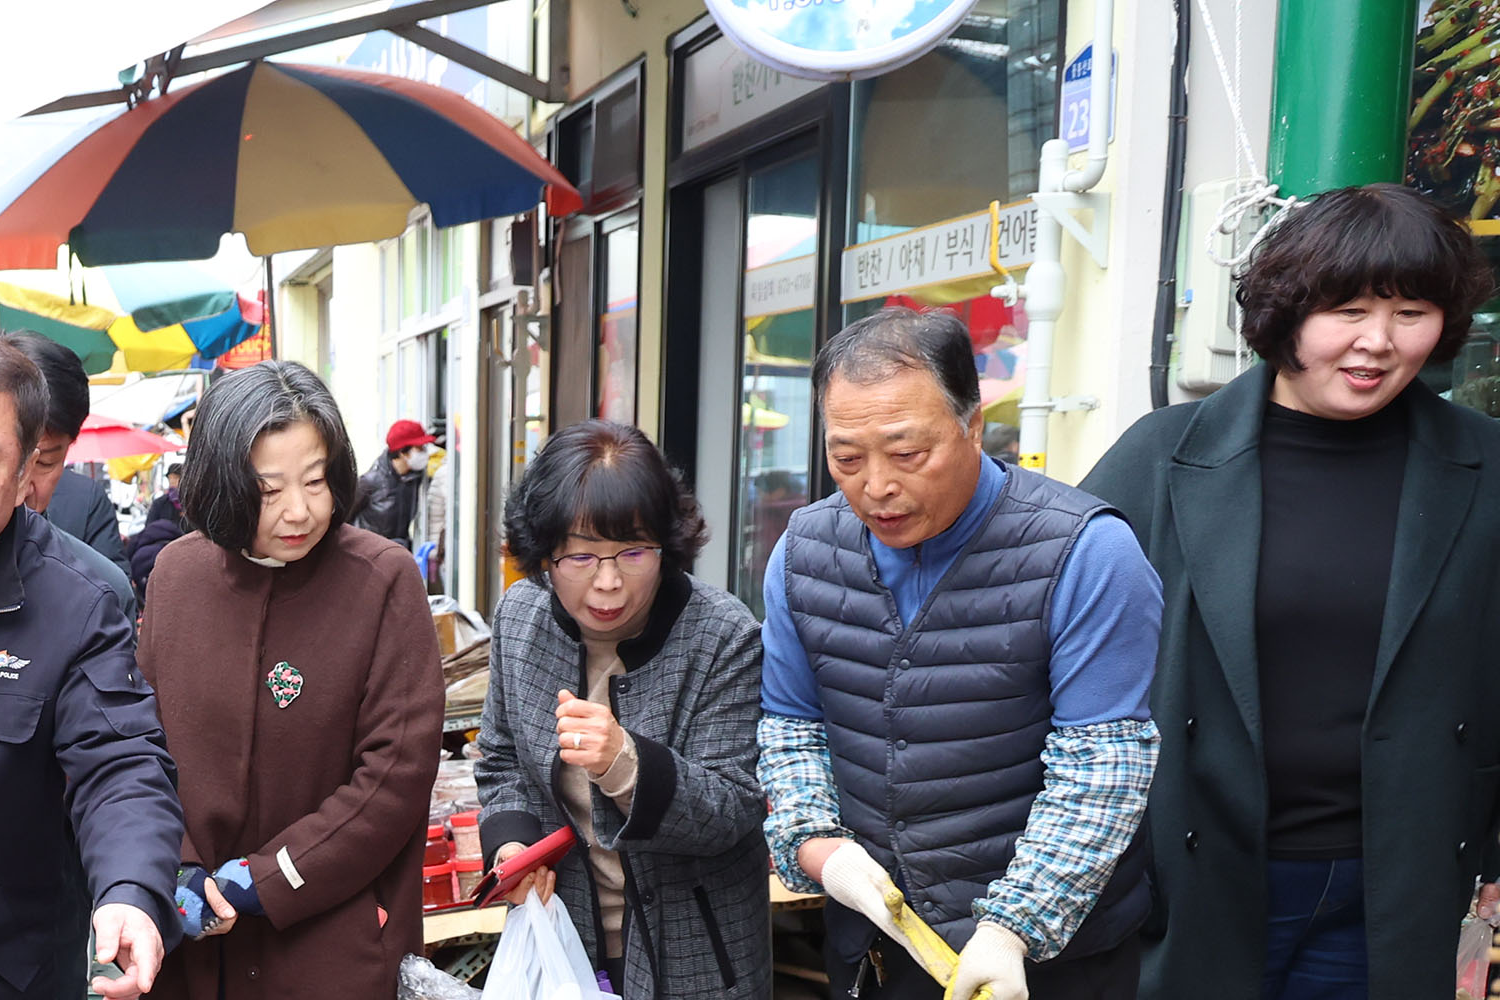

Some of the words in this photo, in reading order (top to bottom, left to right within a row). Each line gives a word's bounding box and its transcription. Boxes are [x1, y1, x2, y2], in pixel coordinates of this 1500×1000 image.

[1067, 99, 1090, 139] 23
[857, 247, 882, 289] 반찬
[899, 236, 926, 281] 야채
[945, 223, 975, 271] 부식
[0, 670, 20, 680] POLICE
